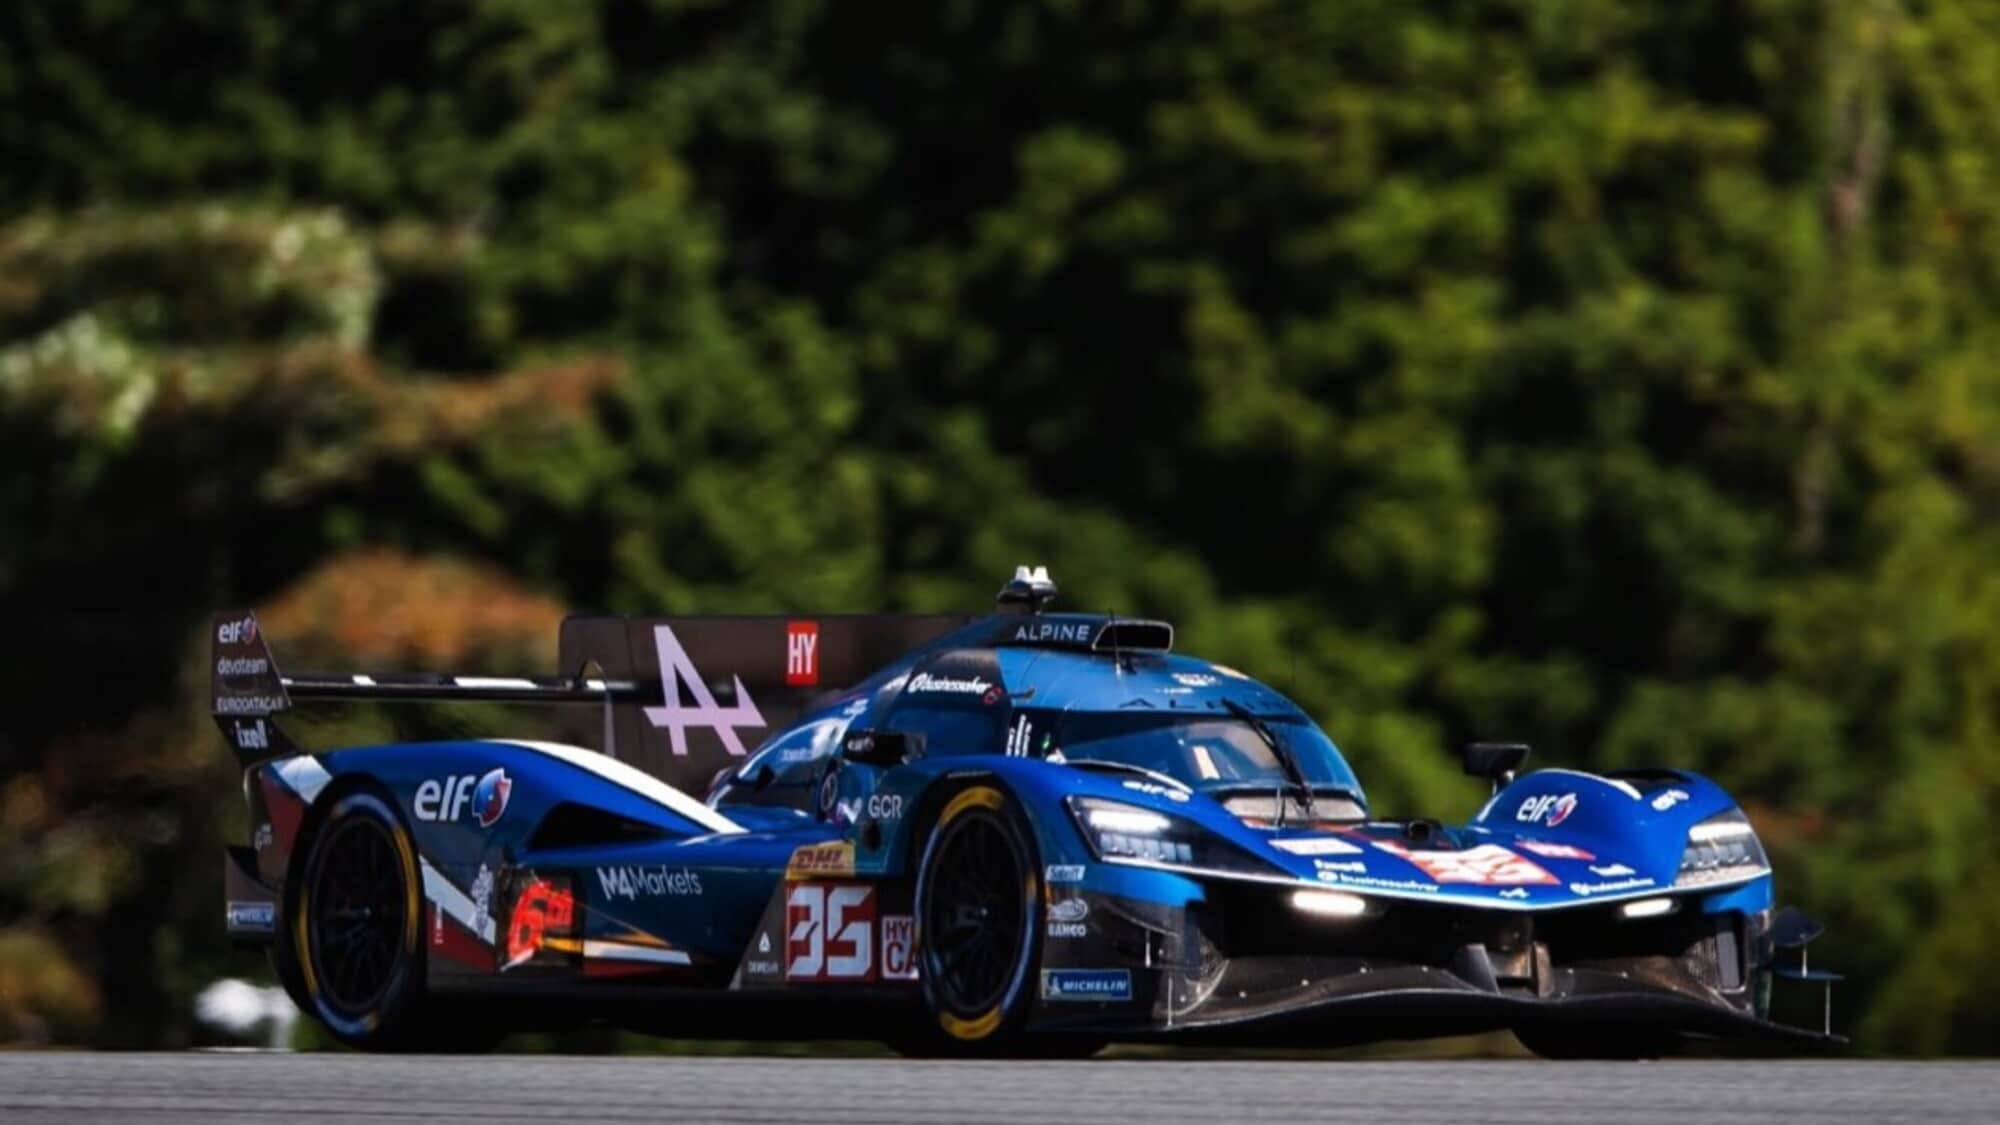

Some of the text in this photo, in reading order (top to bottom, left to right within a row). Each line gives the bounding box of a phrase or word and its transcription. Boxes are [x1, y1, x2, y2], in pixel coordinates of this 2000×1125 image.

[218, 621, 242, 644] elf
[1014, 624, 1091, 643] ALPINE
[217, 657, 268, 675] devoteam
[787, 633, 818, 675] HY
[414, 775, 476, 823] elf
[868, 794, 902, 819] GCR
[1516, 796, 1554, 822] elf
[795, 850, 847, 870] DHL
[597, 865, 703, 901] M4Markets
[787, 885, 873, 977] 35
[1062, 981, 1128, 992] MICHELIN
